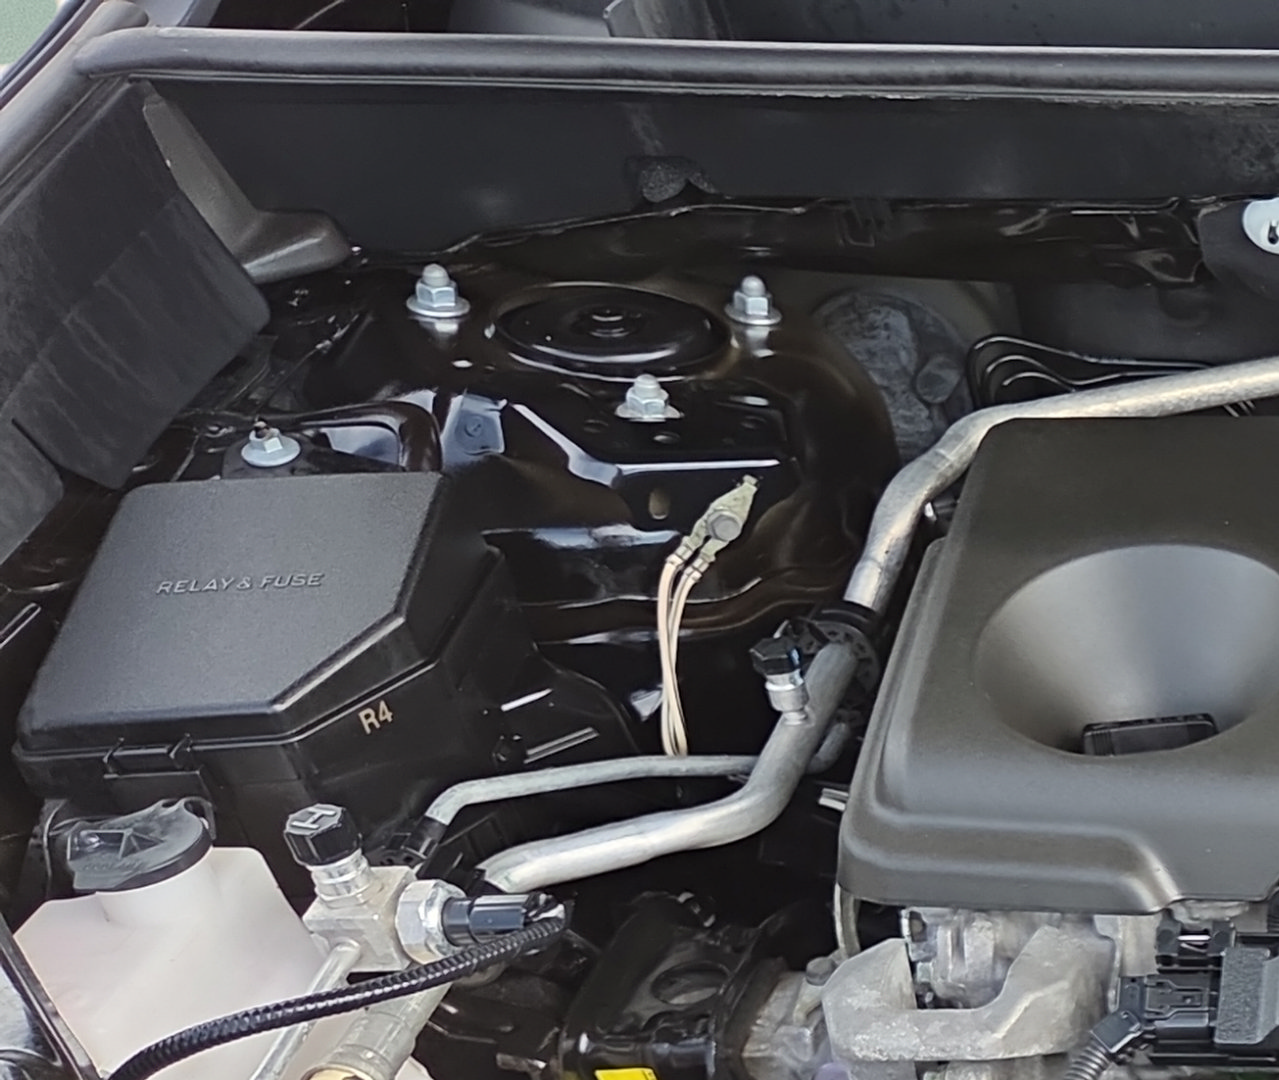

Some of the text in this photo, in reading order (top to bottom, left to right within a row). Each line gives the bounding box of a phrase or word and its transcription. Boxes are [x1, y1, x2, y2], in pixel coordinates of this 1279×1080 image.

[156, 572, 325, 596] RELAY & FUSE
[358, 700, 394, 735] R4
